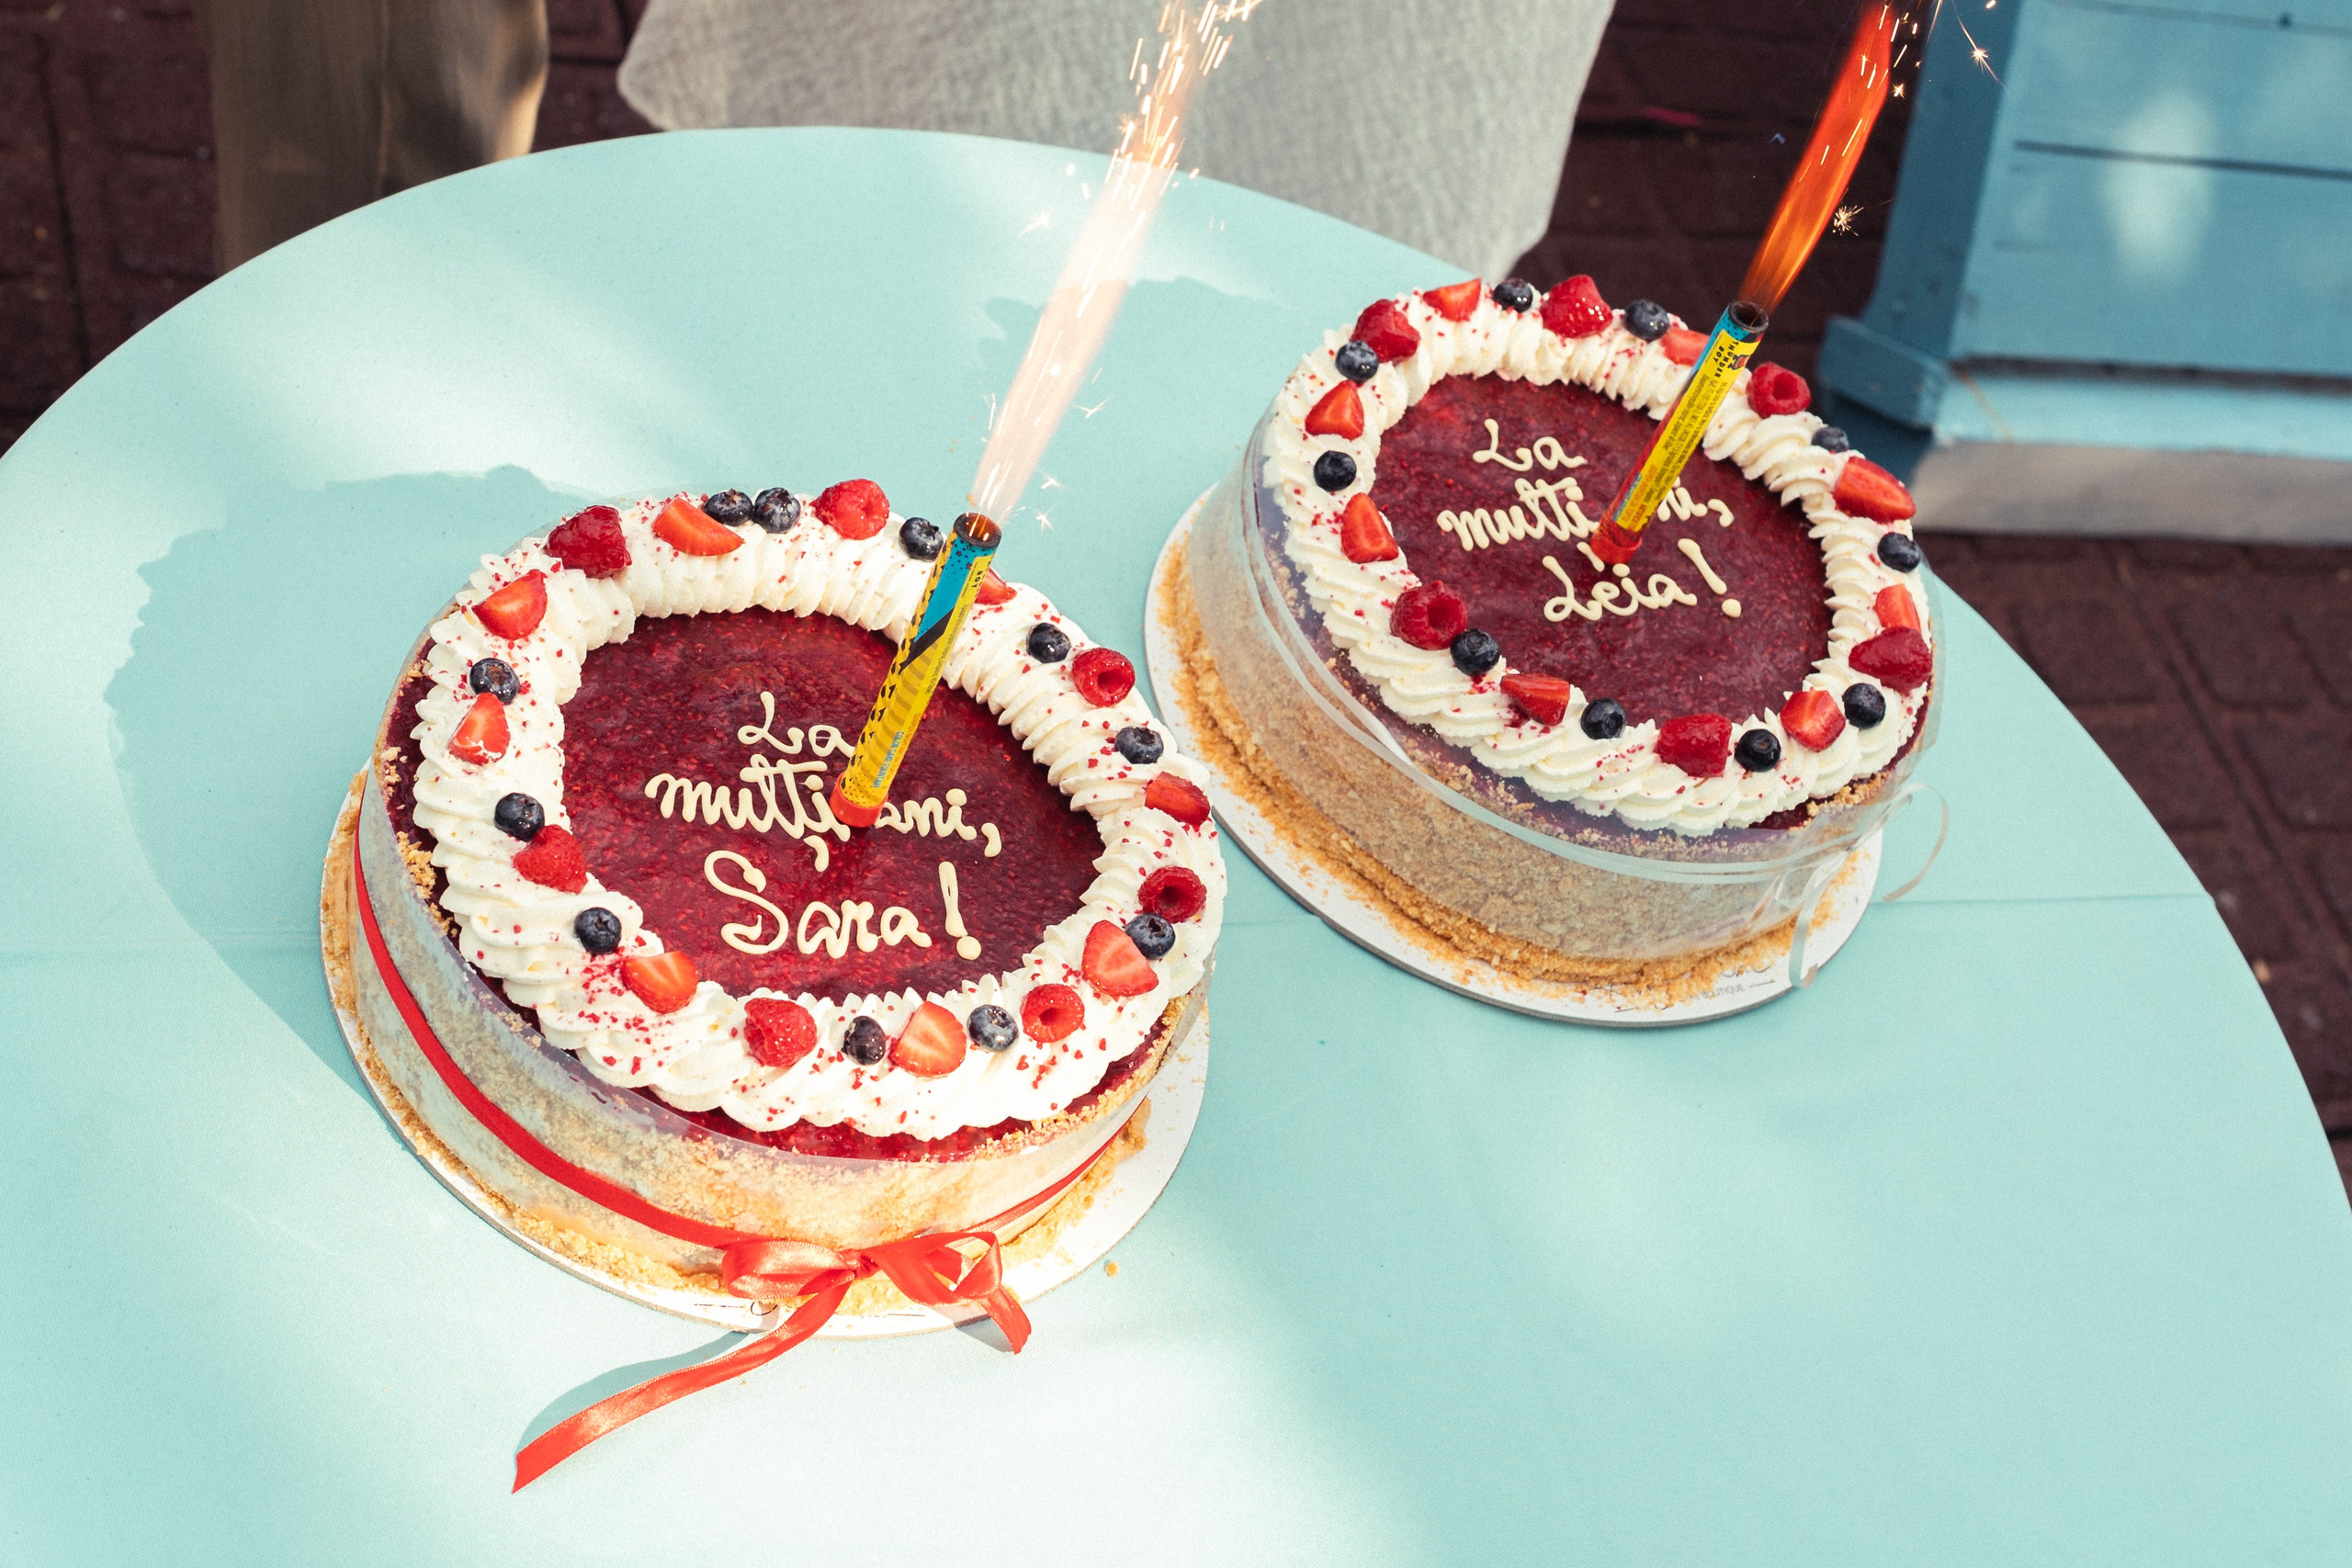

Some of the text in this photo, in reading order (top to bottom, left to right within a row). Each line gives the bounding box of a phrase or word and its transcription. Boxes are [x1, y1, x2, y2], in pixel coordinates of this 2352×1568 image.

[1713, 345, 1725, 364] BOY
[1713, 340, 1739, 378] THUNDER
[1473, 419, 1588, 471] La
[1657, 476, 1735, 527] ni,
[972, 570, 982, 589] BOY
[738, 691, 855, 757] La
[704, 850, 982, 960] Sara!
